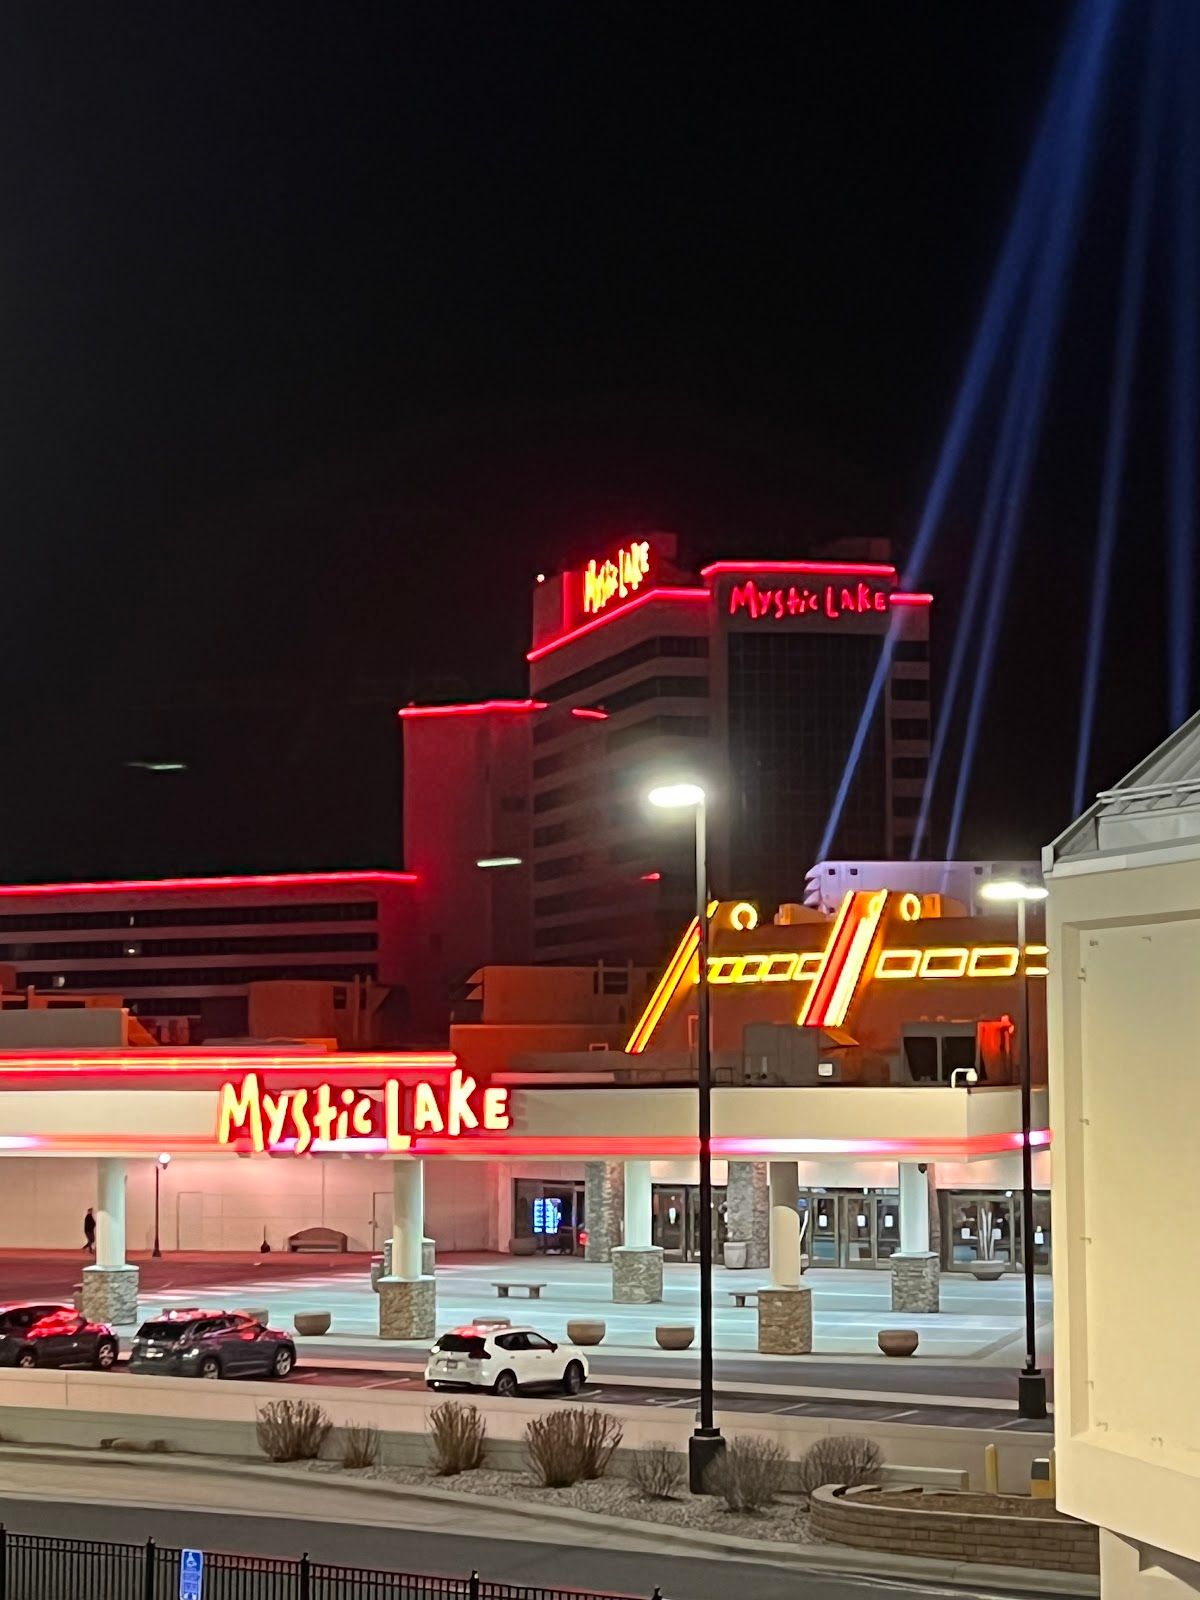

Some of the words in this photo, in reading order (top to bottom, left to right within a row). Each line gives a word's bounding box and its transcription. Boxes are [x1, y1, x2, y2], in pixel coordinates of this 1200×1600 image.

[730, 581, 818, 618] Mystic
[826, 583, 886, 618] LAKE
[218, 1072, 372, 1154] Mystic
[386, 1069, 510, 1151] LAKE
